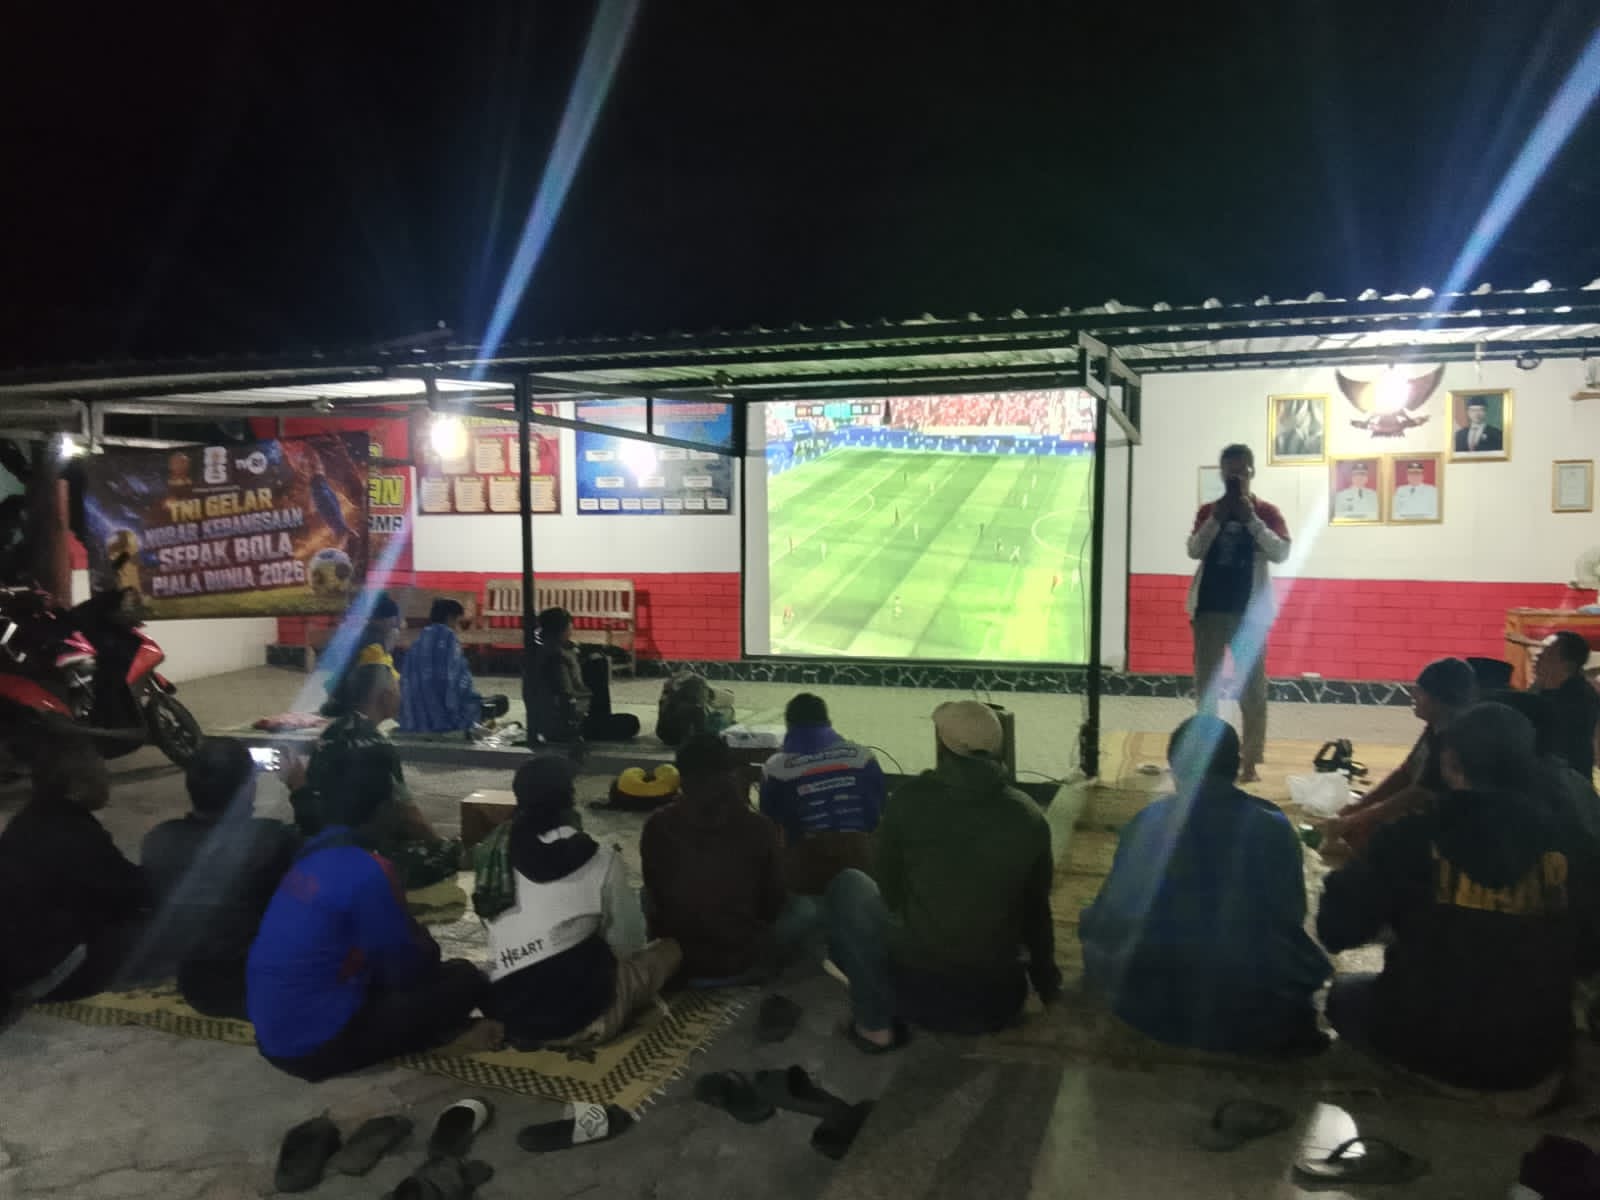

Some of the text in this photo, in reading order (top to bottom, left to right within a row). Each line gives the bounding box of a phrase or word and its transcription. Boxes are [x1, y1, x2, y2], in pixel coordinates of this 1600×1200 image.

[165, 488, 273, 522] TNI GELAR
[159, 532, 294, 572] SEPAK BOLA
[152, 574, 202, 597] PIALA
[258, 560, 305, 586] 2026
[500, 938, 544, 969] HEART
